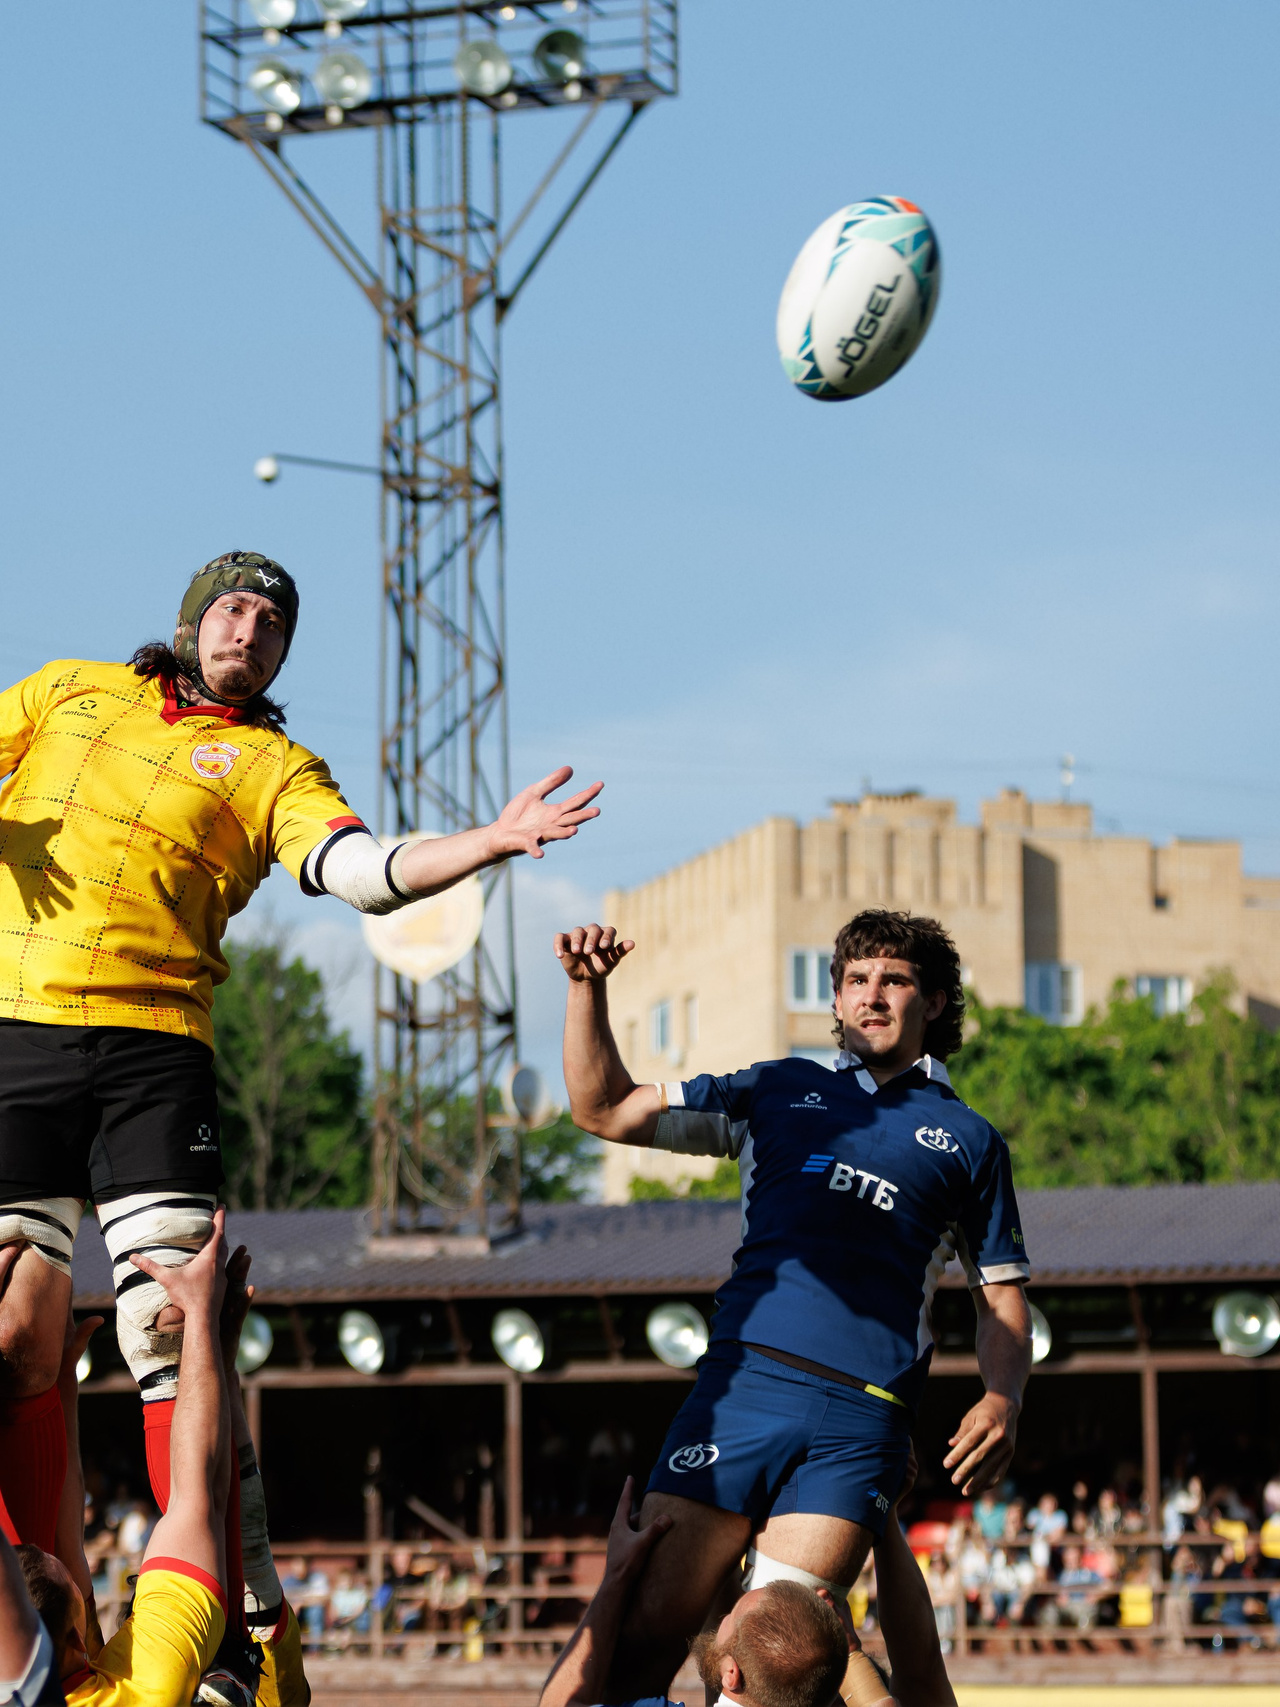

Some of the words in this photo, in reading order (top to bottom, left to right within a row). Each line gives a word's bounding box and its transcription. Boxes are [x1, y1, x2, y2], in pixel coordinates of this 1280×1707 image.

[836, 274, 902, 378] JÖGEL
[61, 711, 98, 721] centurion
[93, 738, 128, 752] МОСКВА
[65, 800, 98, 813] МОСКВА
[104, 813, 130, 826] СЛАВА
[83, 876, 110, 887] СЛАВА
[111, 884, 147, 898] МОСКВА
[2, 929, 25, 937] СЛАВА
[26, 932, 58, 941] МОСКВА
[64, 940, 91, 951] СЛАВА
[829, 1162, 899, 1211] ВТБ
